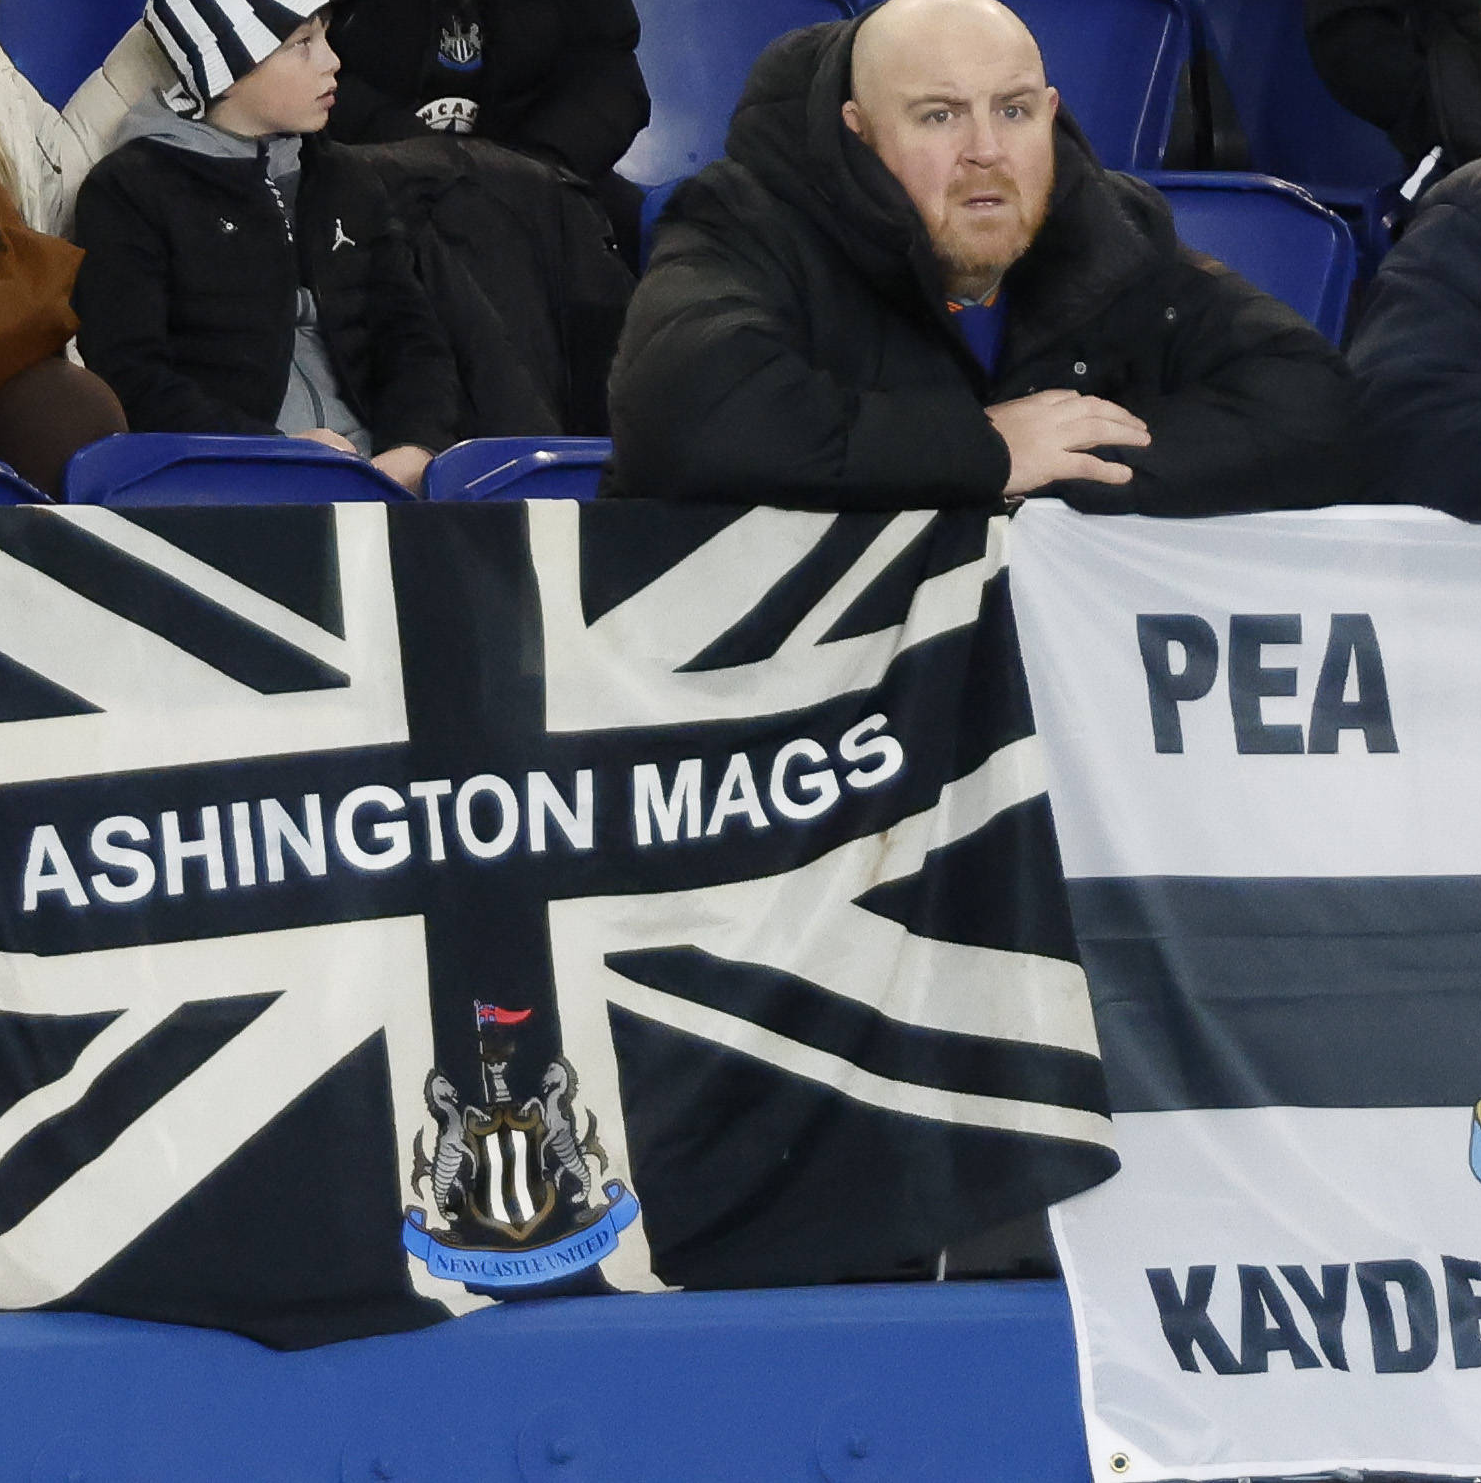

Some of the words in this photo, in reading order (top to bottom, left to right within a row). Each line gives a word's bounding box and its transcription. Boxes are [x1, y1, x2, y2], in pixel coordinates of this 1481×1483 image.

[1136, 614, 1399, 754] PEA
[22, 769, 594, 911] ASHINGTON
[633, 713, 904, 846] MAGS
[437, 1254, 546, 1278] NEWCASTLE
[547, 1230, 610, 1269] UNITED
